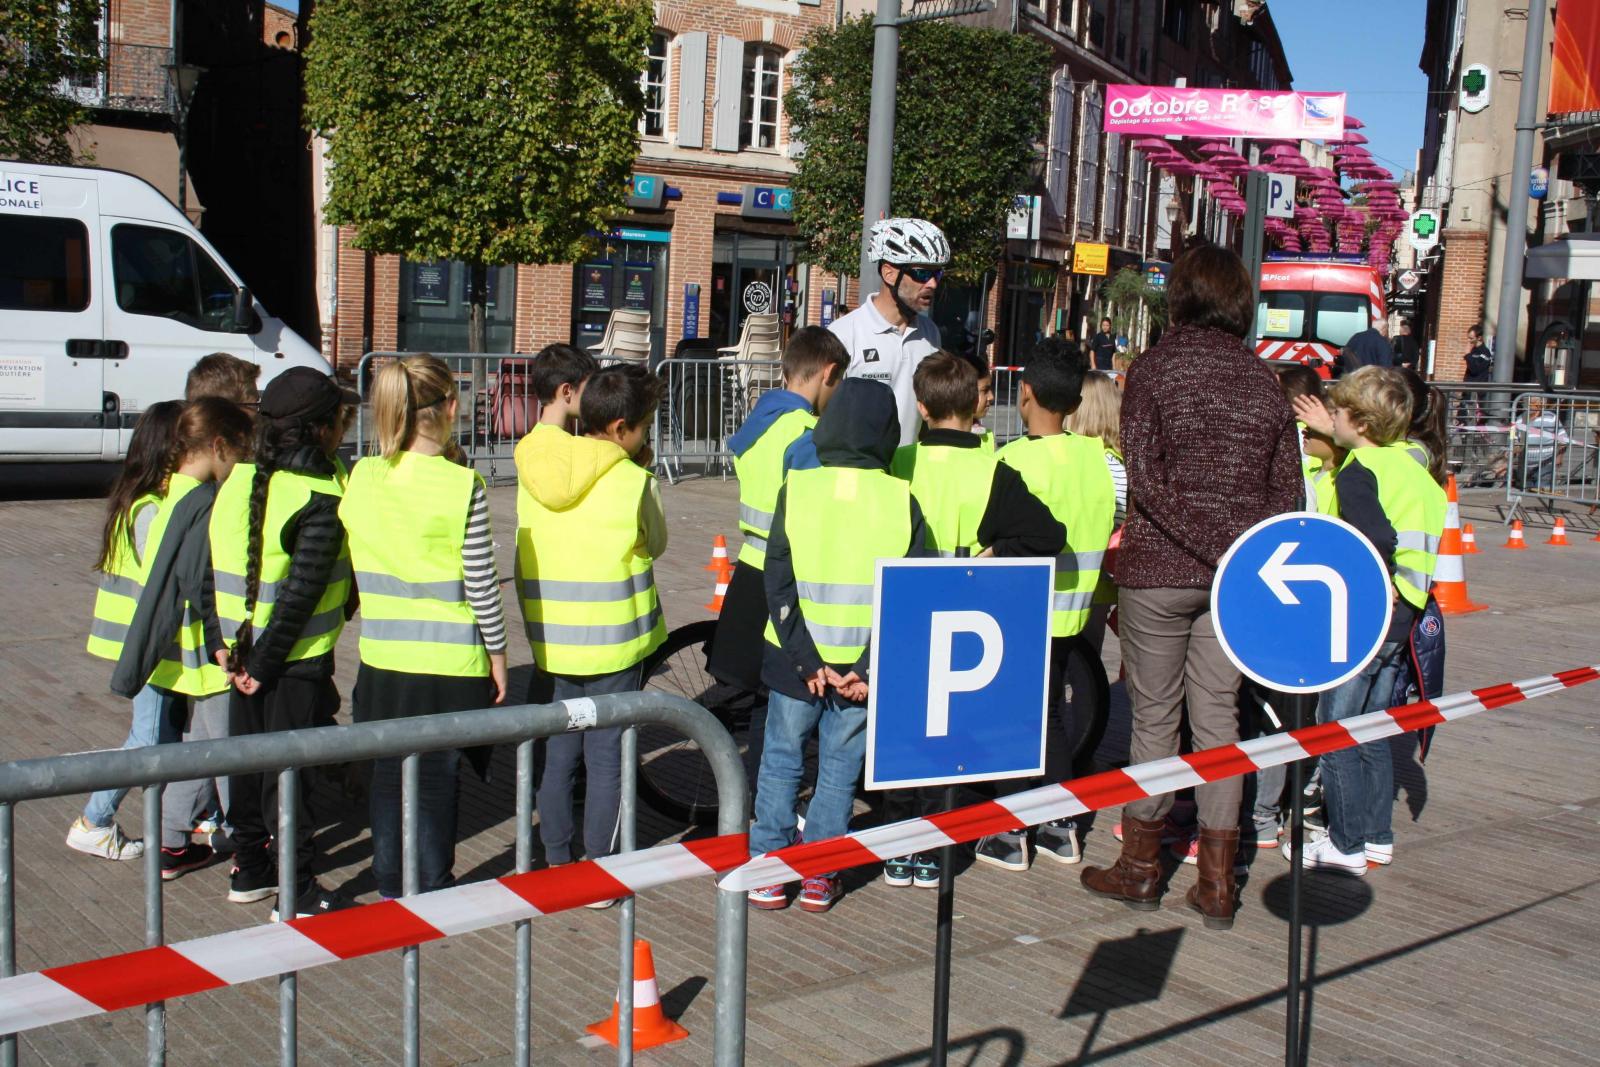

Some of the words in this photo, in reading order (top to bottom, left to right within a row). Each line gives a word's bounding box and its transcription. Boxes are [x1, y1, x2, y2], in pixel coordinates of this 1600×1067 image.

[1109, 97, 1210, 117] Octobre
[1270, 180, 1283, 209] P
[752, 294, 763, 302] 7/7
[926, 611, 1004, 737] P
